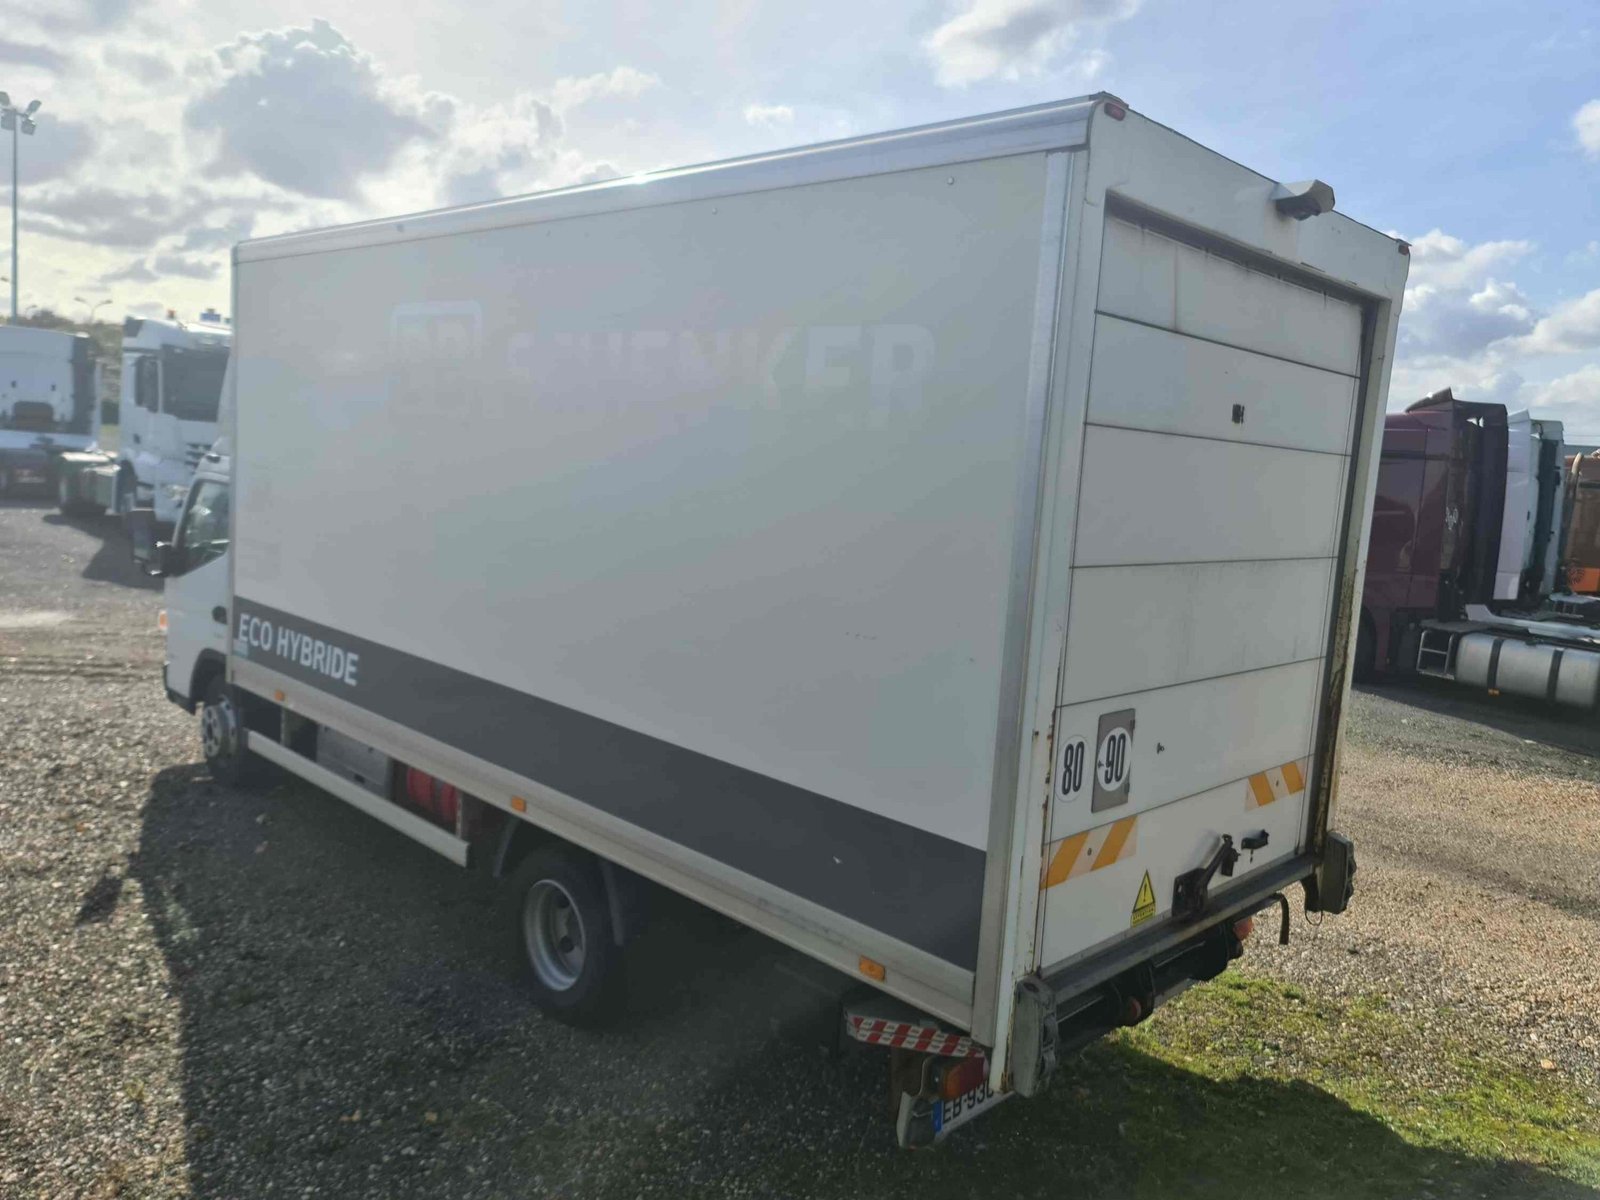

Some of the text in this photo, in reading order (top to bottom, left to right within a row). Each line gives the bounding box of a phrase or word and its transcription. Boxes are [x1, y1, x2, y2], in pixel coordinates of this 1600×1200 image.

[506, 323, 936, 430] SHENKER
[238, 612, 359, 687] ECO HYBRIDE
[1062, 741, 1085, 795] 80
[1104, 733, 1126, 784] 90
